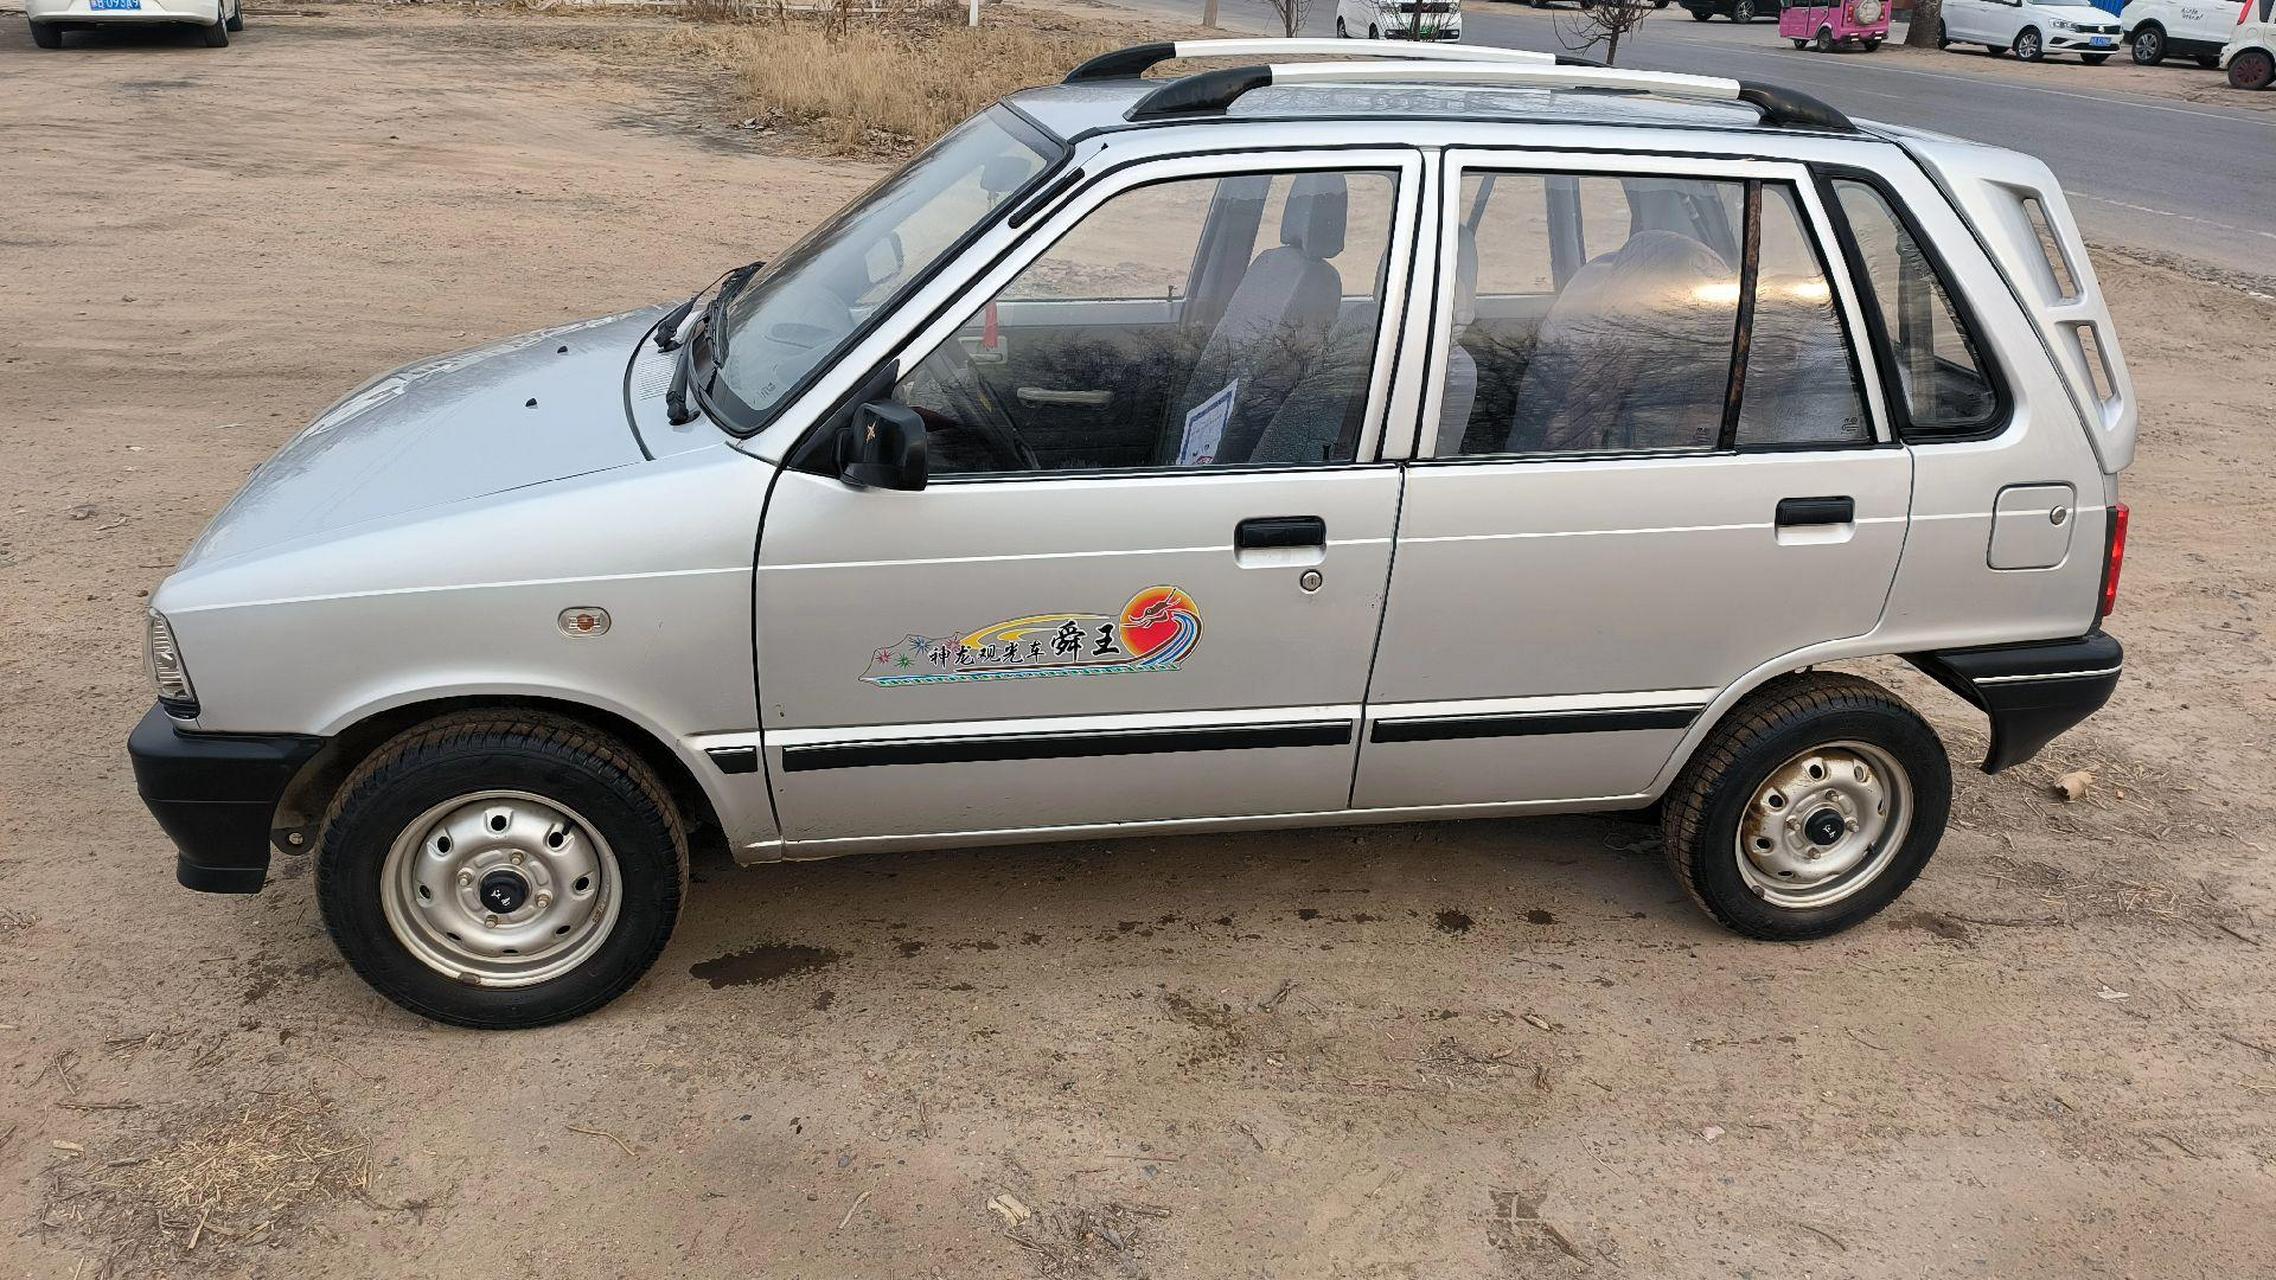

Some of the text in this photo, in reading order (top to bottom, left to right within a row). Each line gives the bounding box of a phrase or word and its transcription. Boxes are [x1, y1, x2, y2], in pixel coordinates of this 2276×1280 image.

[929, 620, 1120, 668] 神龙观光车 舜王
